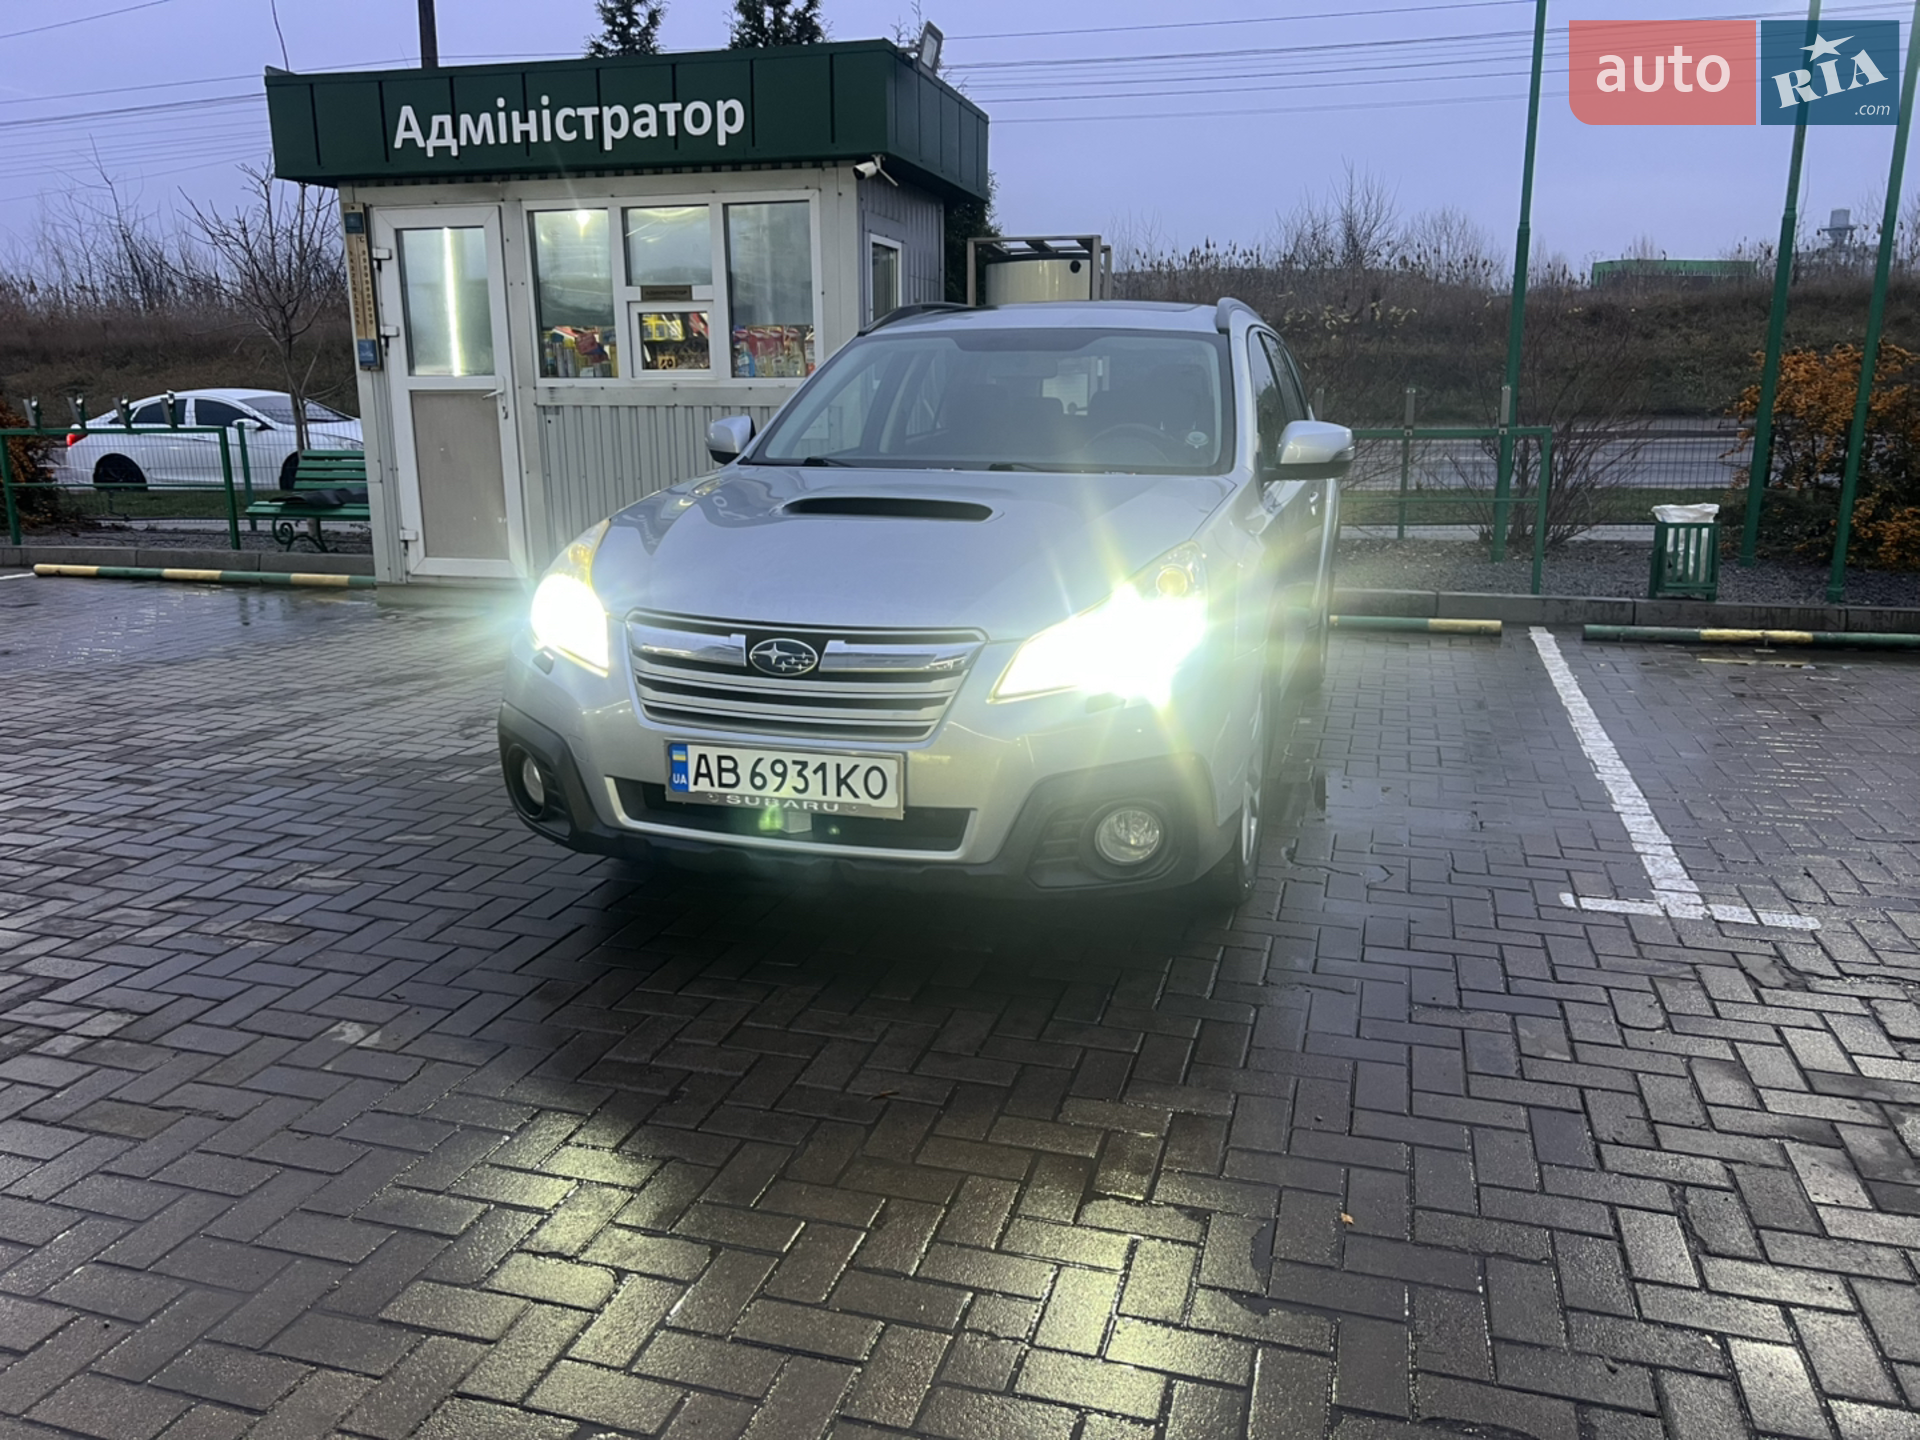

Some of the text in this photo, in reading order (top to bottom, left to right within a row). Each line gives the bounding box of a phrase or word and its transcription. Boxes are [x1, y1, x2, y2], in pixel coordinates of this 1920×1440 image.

[394, 95, 746, 158] Адміністратор
[672, 772, 688, 785] UA
[725, 794, 839, 813] SUBARU
